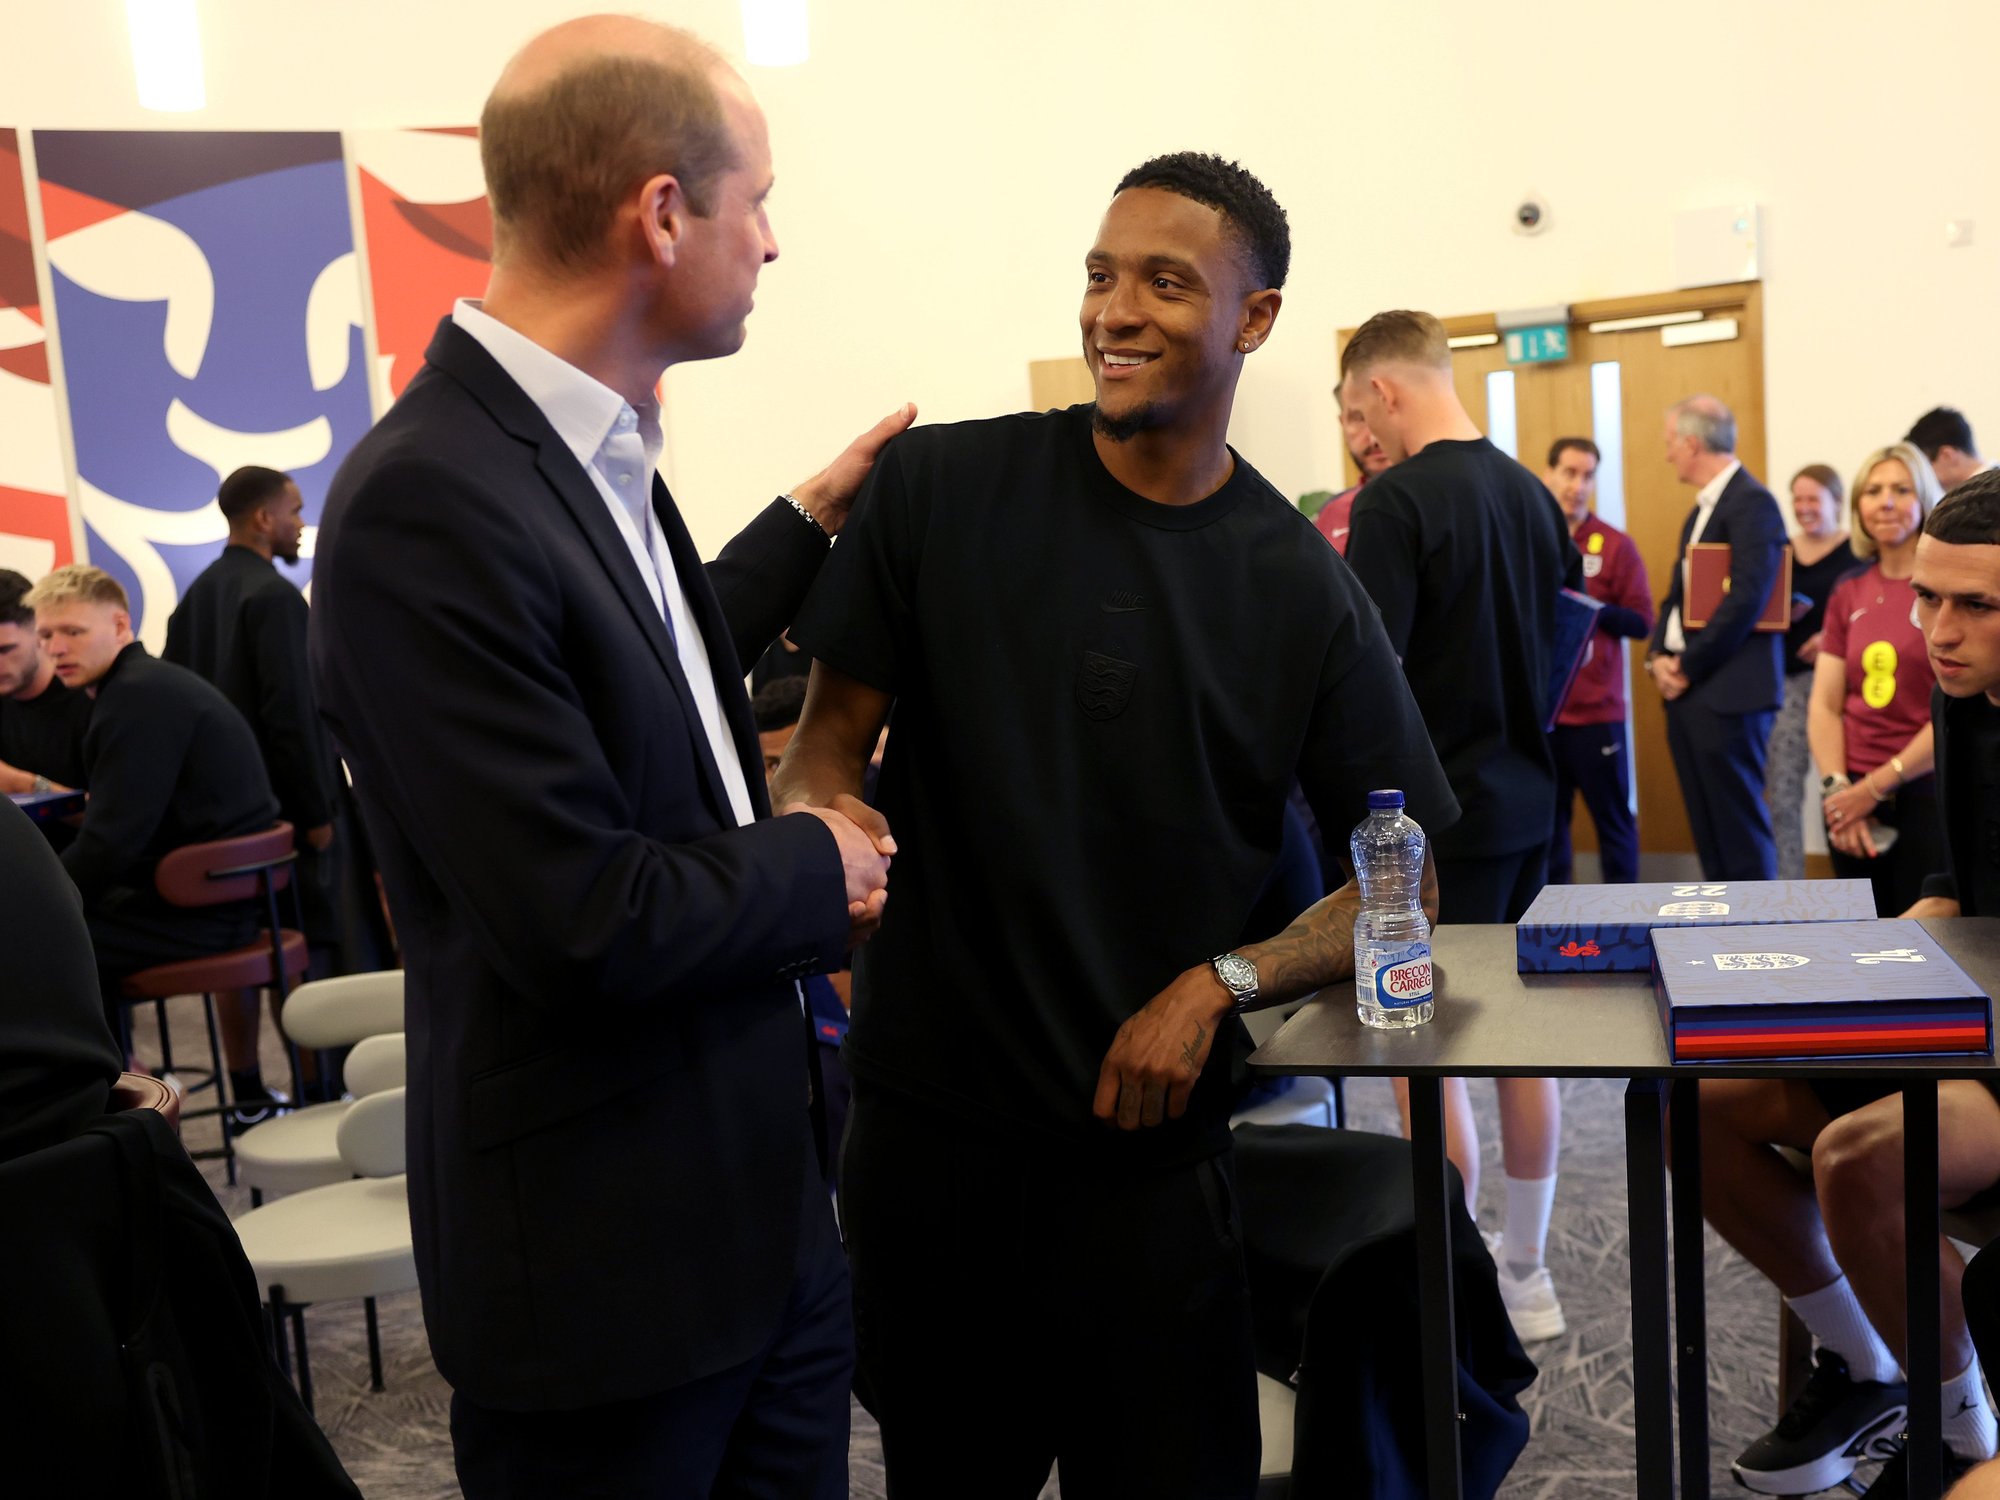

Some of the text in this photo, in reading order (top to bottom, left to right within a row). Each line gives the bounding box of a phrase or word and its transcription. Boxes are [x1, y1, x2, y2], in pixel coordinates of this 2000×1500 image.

[1672, 885, 1727, 897] 22
[1390, 963, 1431, 981] BRECON
[1390, 975, 1431, 993] CARREG
